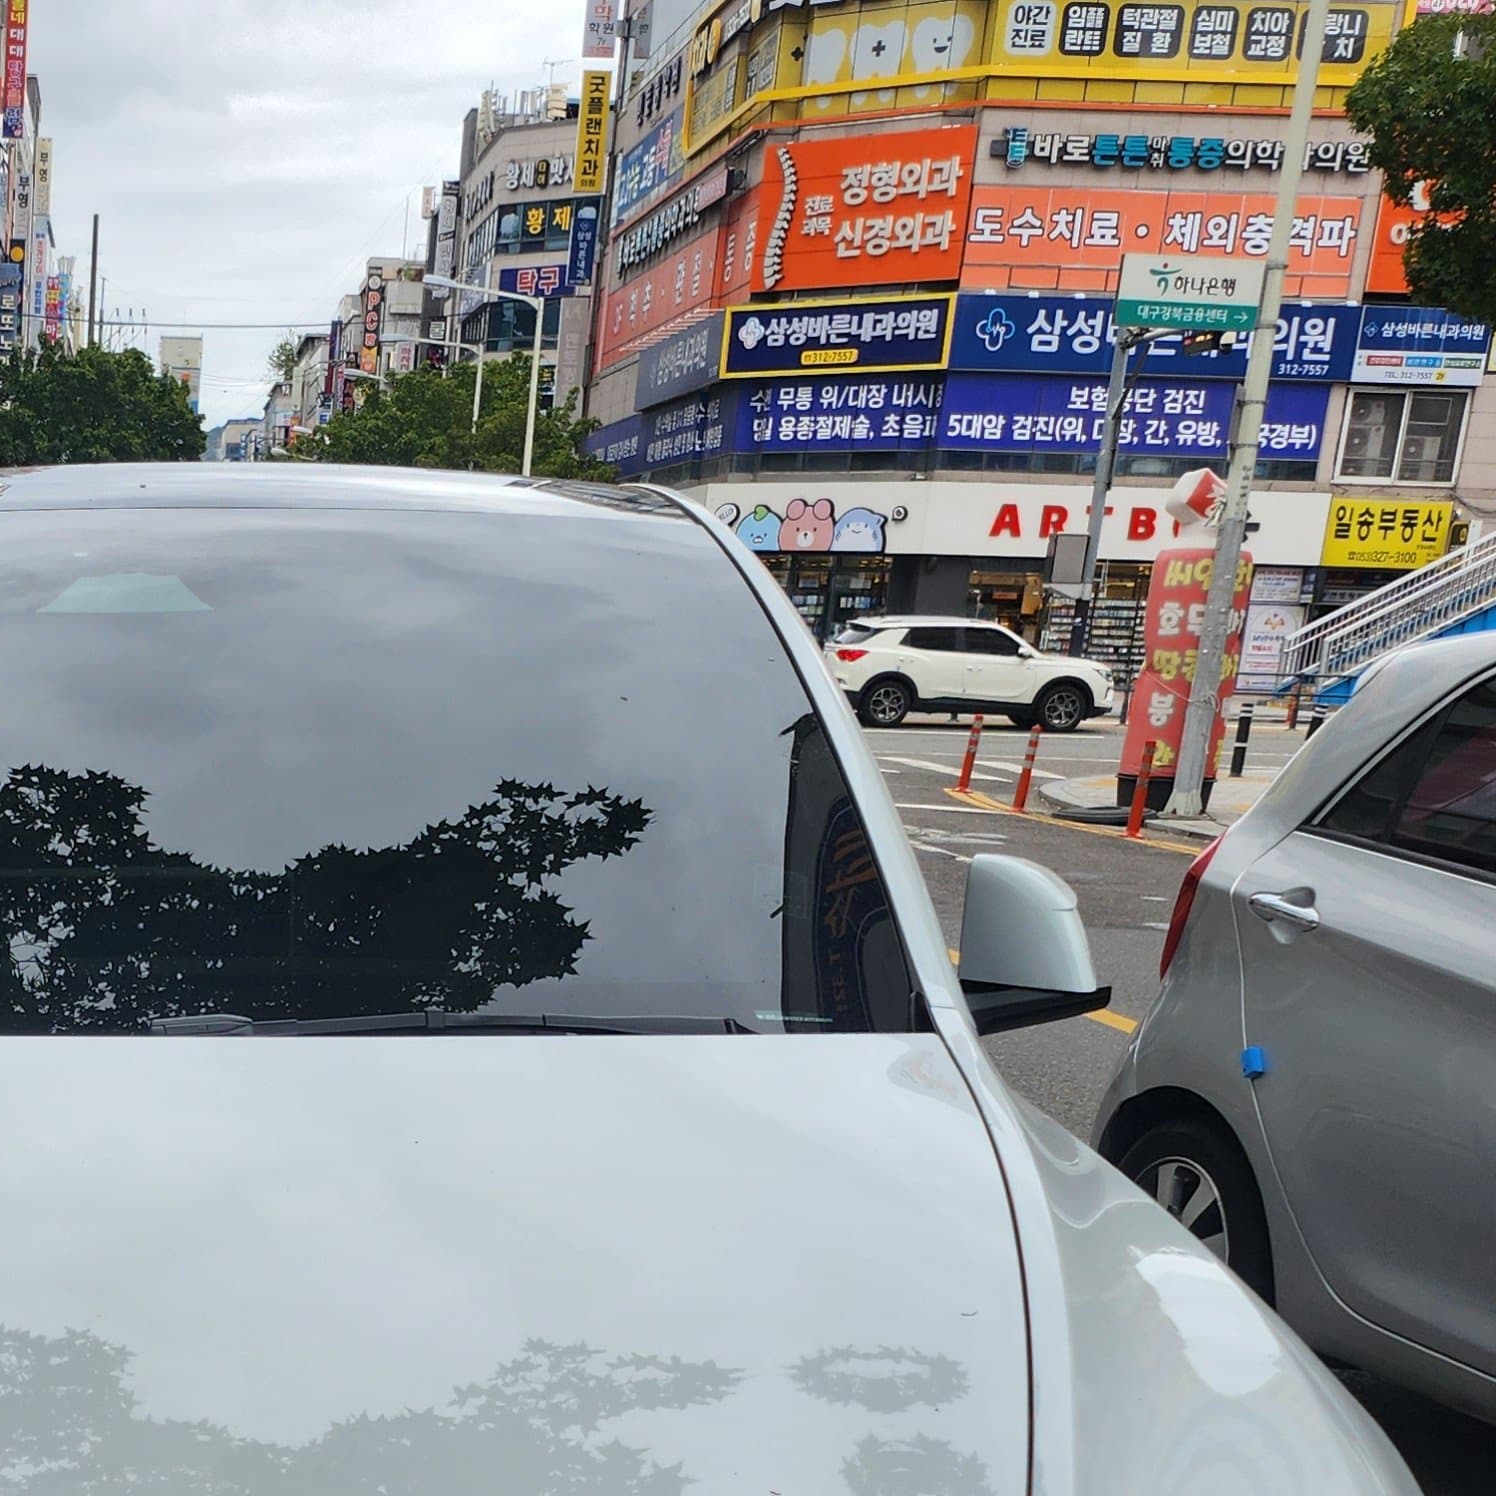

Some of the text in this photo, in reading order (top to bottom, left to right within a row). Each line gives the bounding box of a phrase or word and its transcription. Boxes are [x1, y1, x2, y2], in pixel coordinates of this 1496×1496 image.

[1014, 5, 1051, 27] 야간
[1122, 9, 1179, 33] 턱관절
[1198, 9, 1234, 32] 심미
[1252, 12, 1290, 35] 치아
[1010, 28, 1047, 49] 진료
[1194, 33, 1233, 56] 보철
[1248, 35, 1286, 58] 교정
[581, 76, 606, 177] 굿플랜치과
[840, 156, 964, 206] 정형외과
[805, 195, 835, 216] 진료
[526, 206, 571, 234] 황제
[968, 208, 1120, 248] 도수치료
[834, 210, 957, 259] 신경외과
[517, 267, 560, 296] 탁구
[1174, 274, 1237, 297] 하나은행
[765, 309, 939, 347] 삼성바른내과의원
[1381, 321, 1485, 340] 삼성바른내과의원
[812, 350, 854, 363] 312-7557
[1278, 364, 1329, 376] 312-7557
[777, 386, 813, 411] 무통
[819, 385, 888, 410] 위/대장
[1162, 389, 1206, 415] 검진
[947, 414, 1006, 439] 5대암
[1334, 505, 1442, 543] 일송부동산
